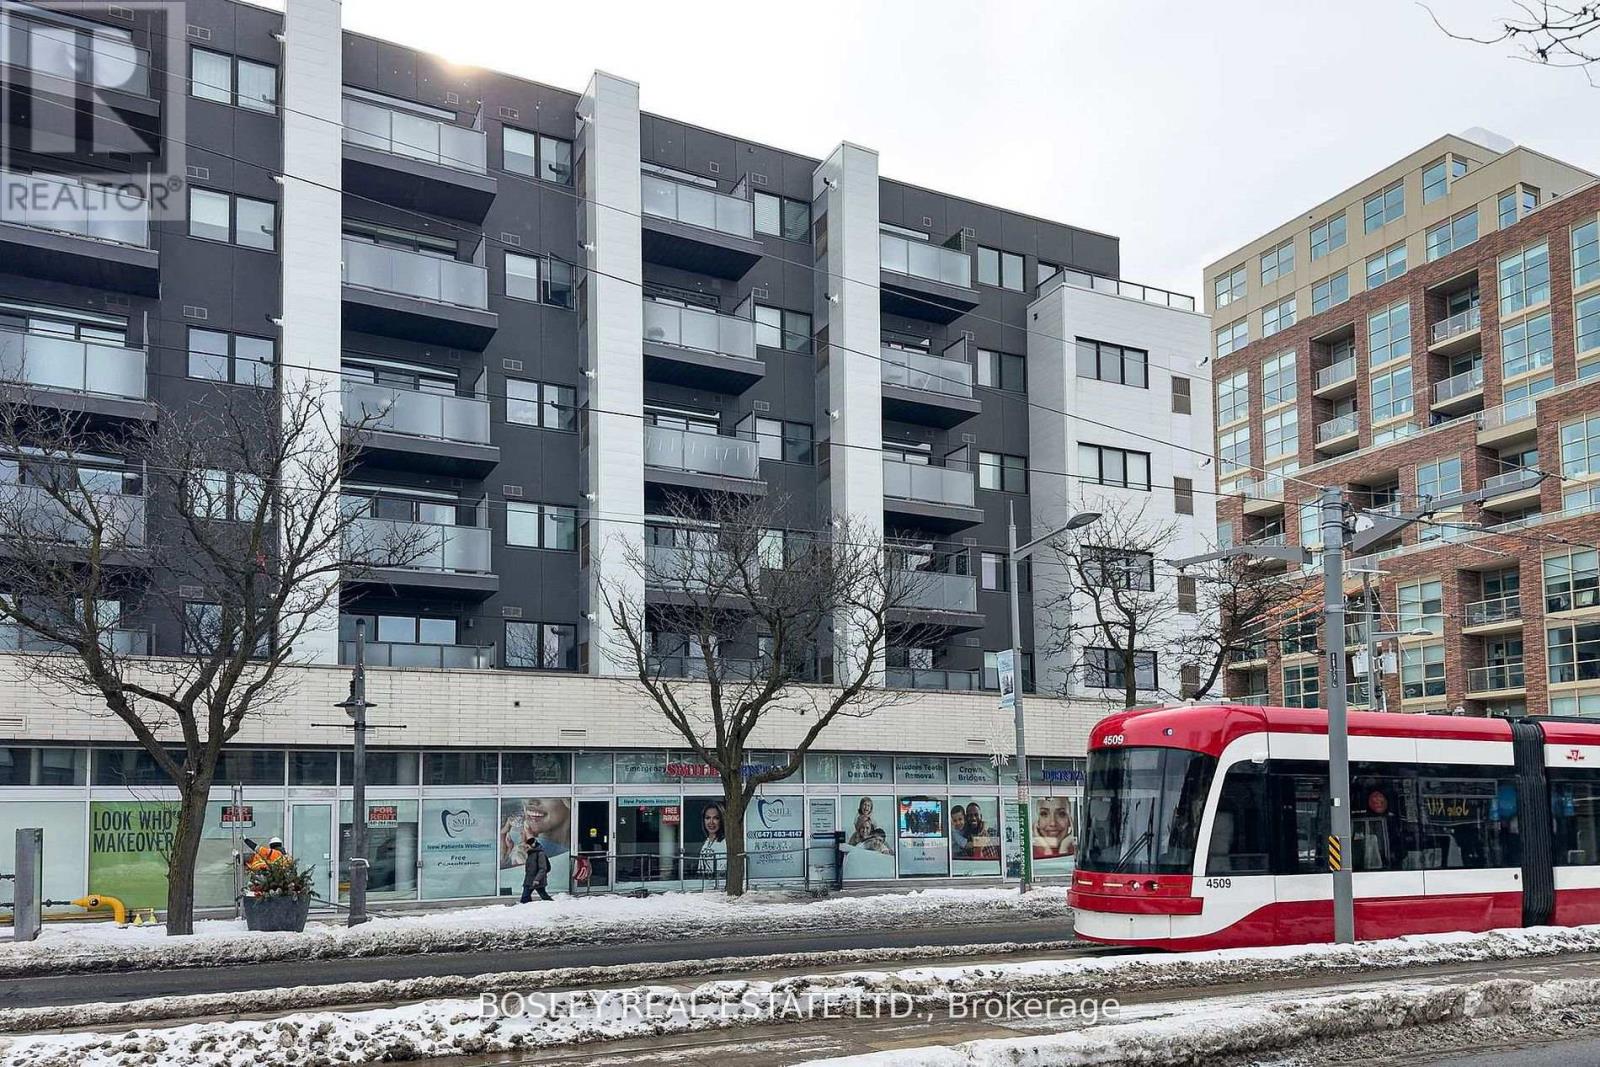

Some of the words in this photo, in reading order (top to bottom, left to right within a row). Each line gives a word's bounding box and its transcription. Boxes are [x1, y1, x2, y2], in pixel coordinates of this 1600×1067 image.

[1103, 735, 1124, 745] 4509
[93, 811, 131, 831] LOOK
[93, 833, 174, 853] MAKEOVER
[1206, 878, 1232, 889] 4509
